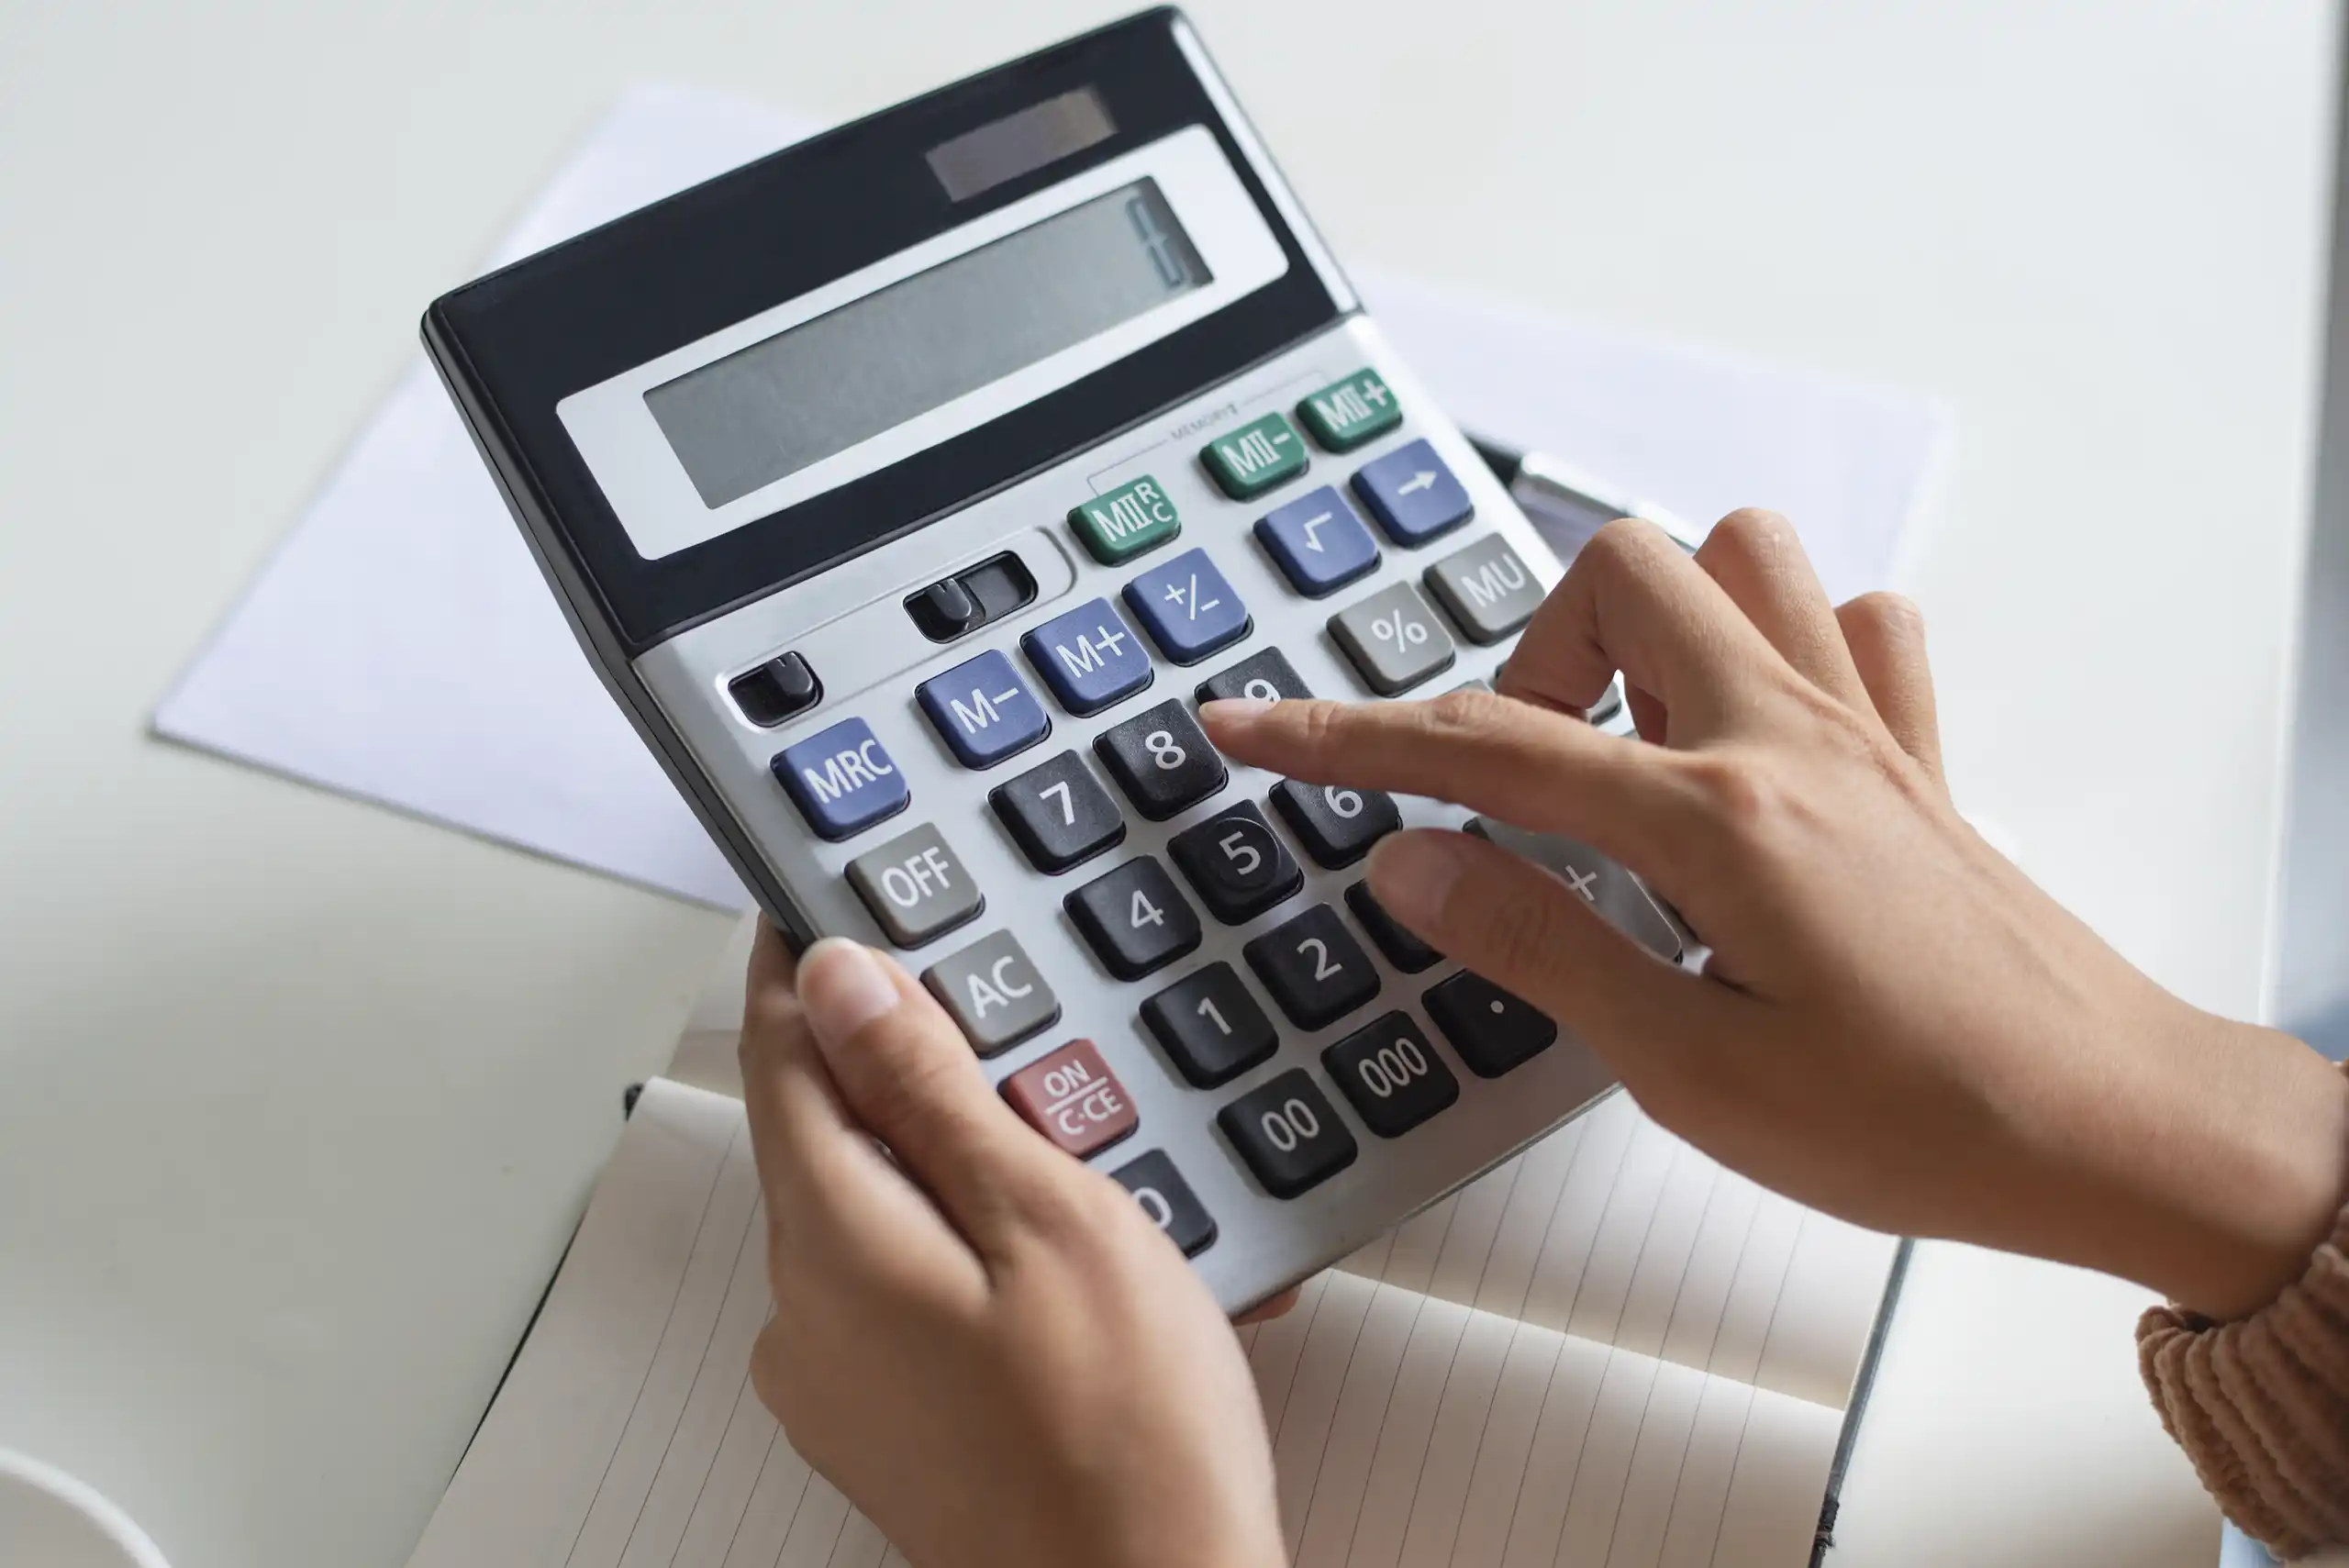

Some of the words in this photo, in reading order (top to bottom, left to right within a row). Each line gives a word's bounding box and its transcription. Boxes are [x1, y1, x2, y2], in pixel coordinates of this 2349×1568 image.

[1461, 556, 1526, 608] MU
[1055, 626, 1125, 679] M+
[1370, 608, 1428, 654] %
[950, 687, 1019, 735] M-
[1244, 679, 1281, 706] 9
[802, 738, 894, 805] MRC
[1144, 729, 1186, 769] 8
[1039, 781, 1075, 826] 7
[1325, 785, 1364, 818] 6
[1219, 830, 1262, 875] 5
[881, 845, 951, 909] OFF
[1130, 889, 1164, 929] 4
[1297, 938, 1342, 982] 2
[966, 954, 1033, 1019] AC
[1197, 996, 1232, 1035] 1
[1043, 1059, 1091, 1098] ON
[1357, 1036, 1429, 1097] 000
[1261, 1098, 1319, 1151] 00
